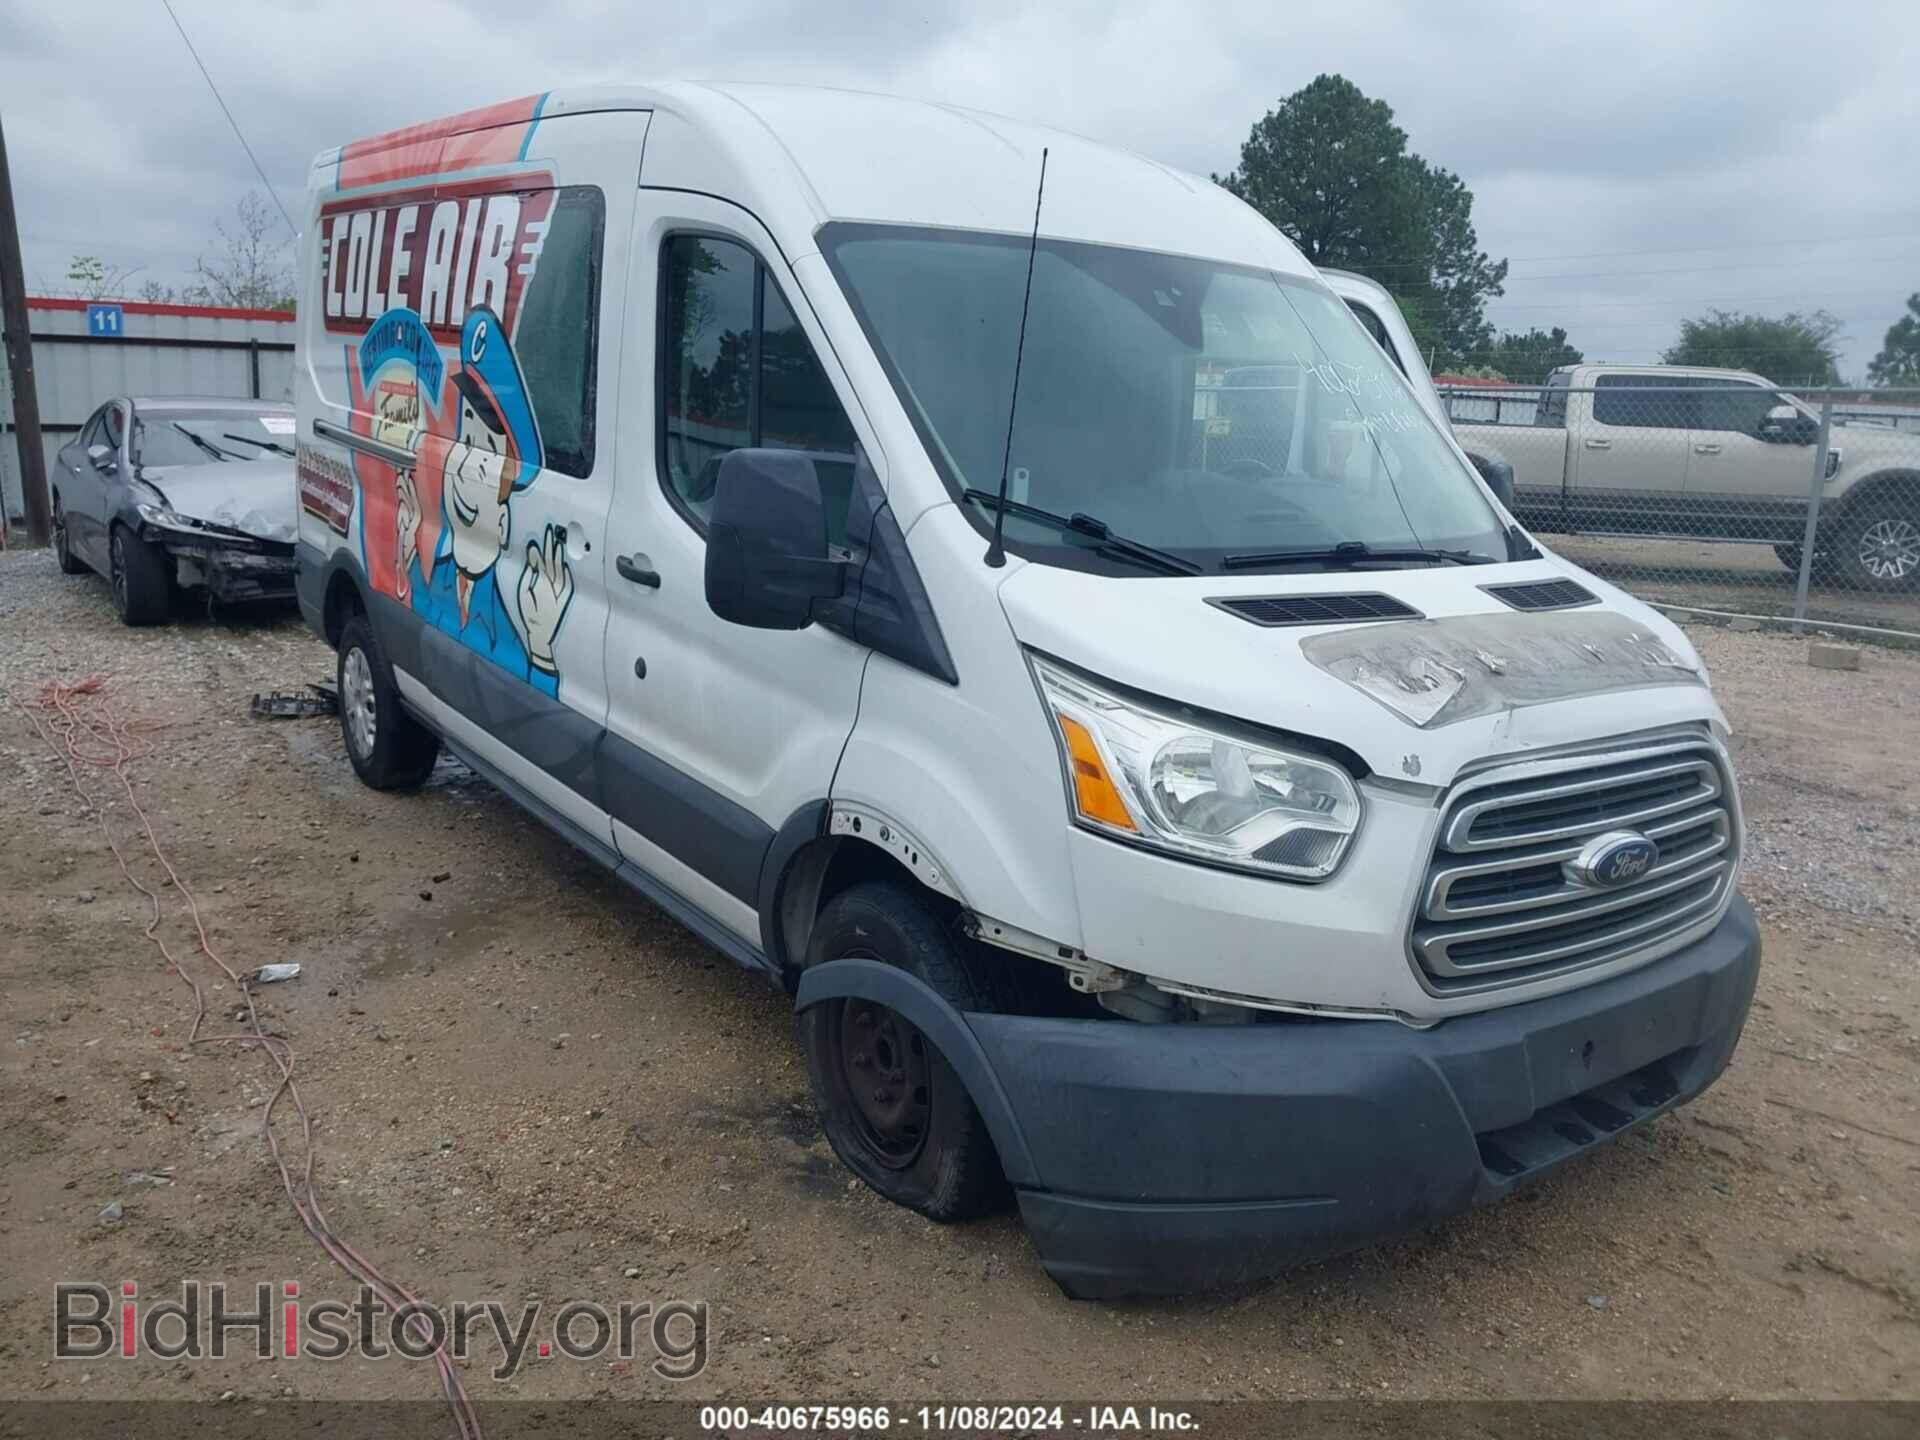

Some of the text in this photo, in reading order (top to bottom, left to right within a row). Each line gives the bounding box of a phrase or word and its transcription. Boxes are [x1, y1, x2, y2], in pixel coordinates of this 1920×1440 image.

[326, 195, 521, 326] COLE AIR
[95, 311, 118, 331] 11
[470, 319, 488, 364] C
[1610, 847, 1649, 879] Ford
